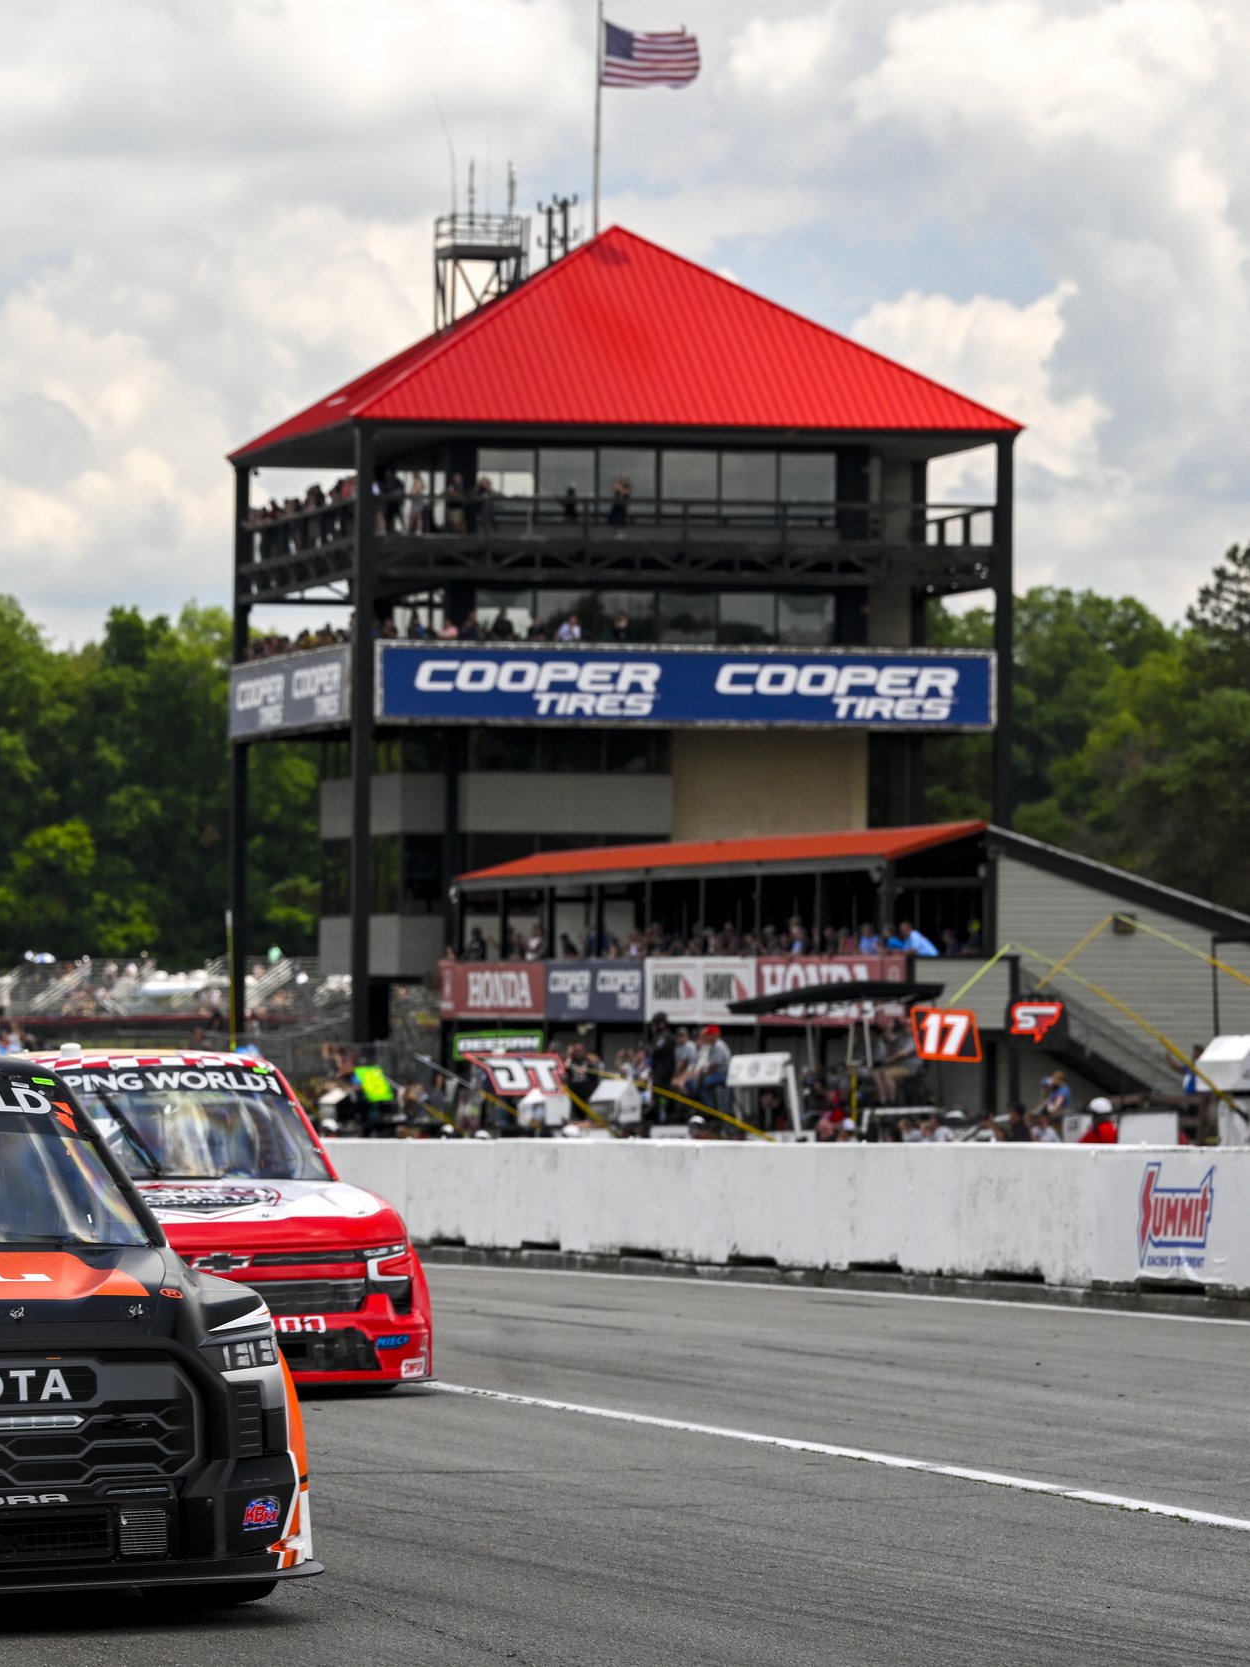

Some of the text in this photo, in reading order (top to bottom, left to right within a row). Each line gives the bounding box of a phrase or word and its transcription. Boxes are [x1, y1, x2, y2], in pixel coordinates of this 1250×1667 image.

[414, 660, 662, 692] COOPER
[715, 663, 965, 697] COOPER
[533, 693, 655, 716] TIRES
[832, 696, 952, 720] TIRES
[466, 970, 533, 1008] HONDA
[921, 1012, 969, 1056] 17
[145, 1070, 268, 1092] WORLD
[1138, 1166, 1211, 1252] SUMMIT
[243, 1503, 279, 1526] KBM
